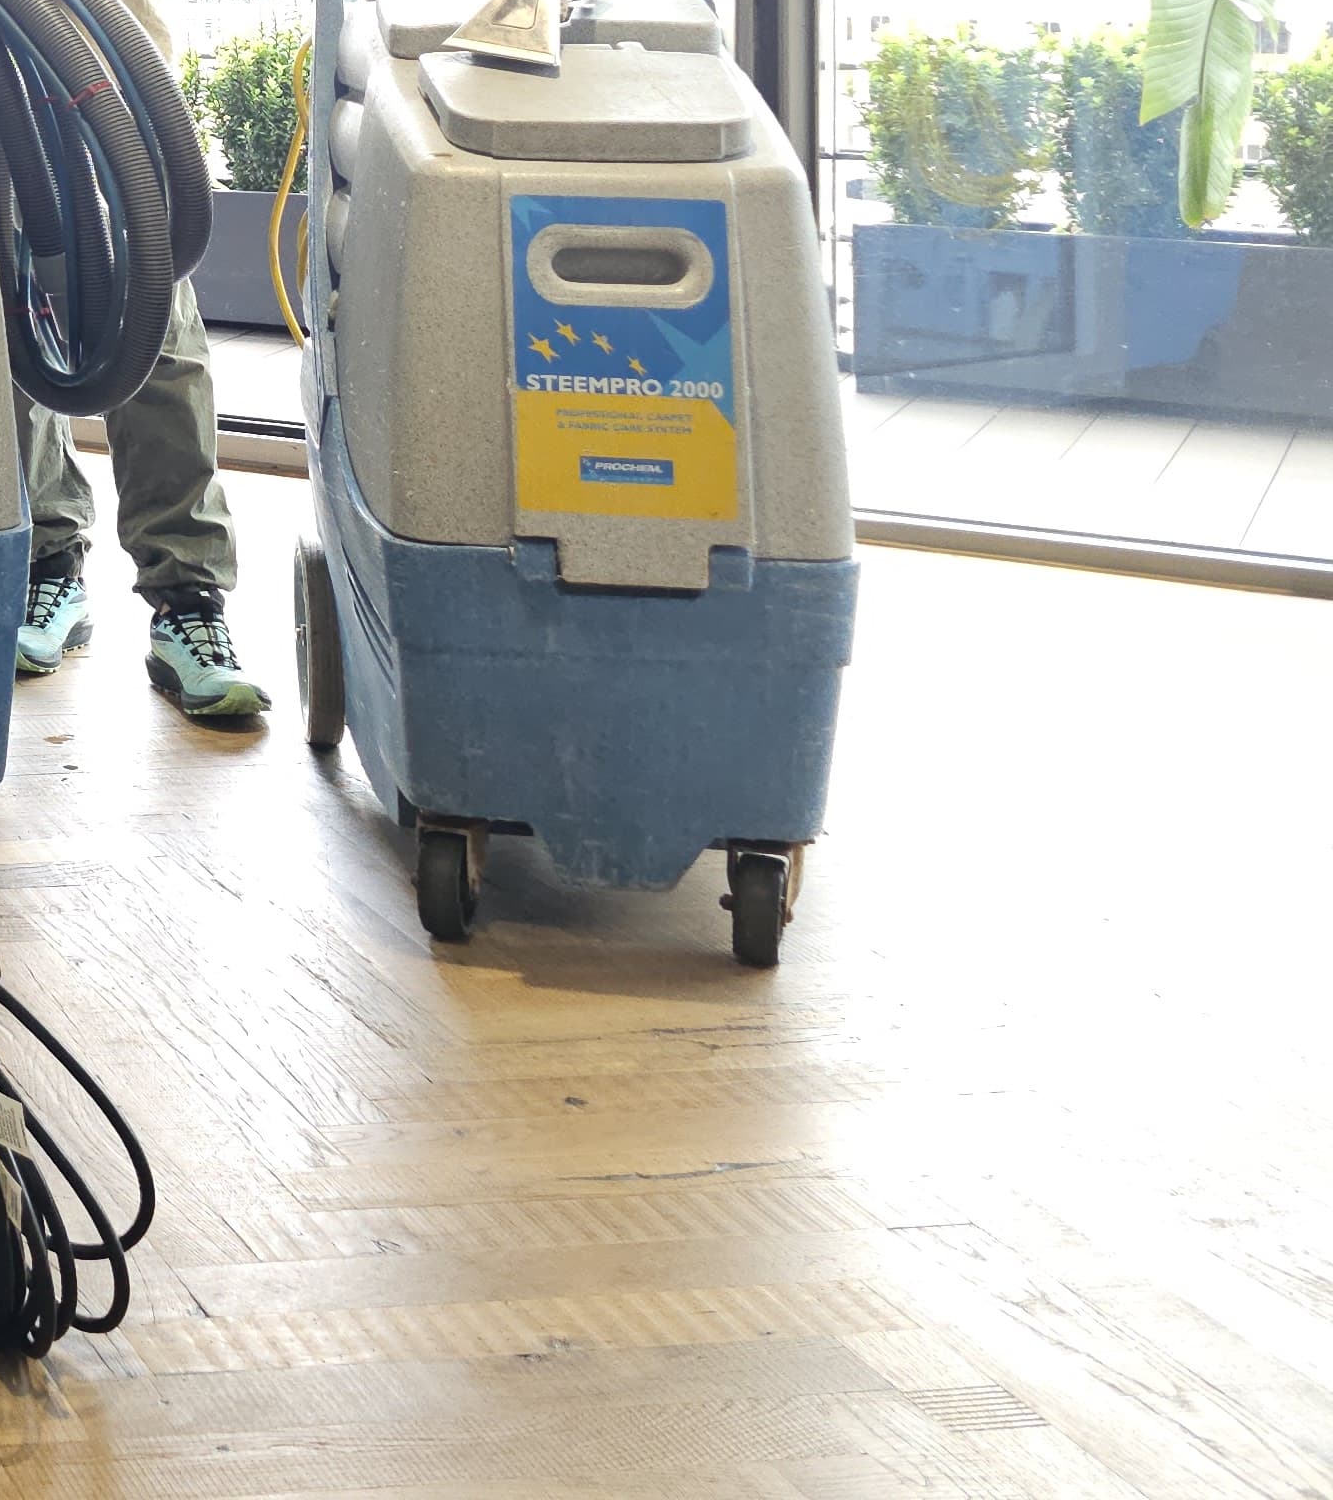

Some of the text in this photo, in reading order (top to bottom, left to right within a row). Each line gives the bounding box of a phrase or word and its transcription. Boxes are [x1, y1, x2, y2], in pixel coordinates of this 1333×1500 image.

[526, 374, 724, 399] STEEMPRO 2000
[556, 409, 694, 422] PROFESSIONAL CARPET
[568, 421, 609, 432] FABRIC
[613, 423, 644, 433] CARE
[647, 424, 693, 435] SYSTEM
